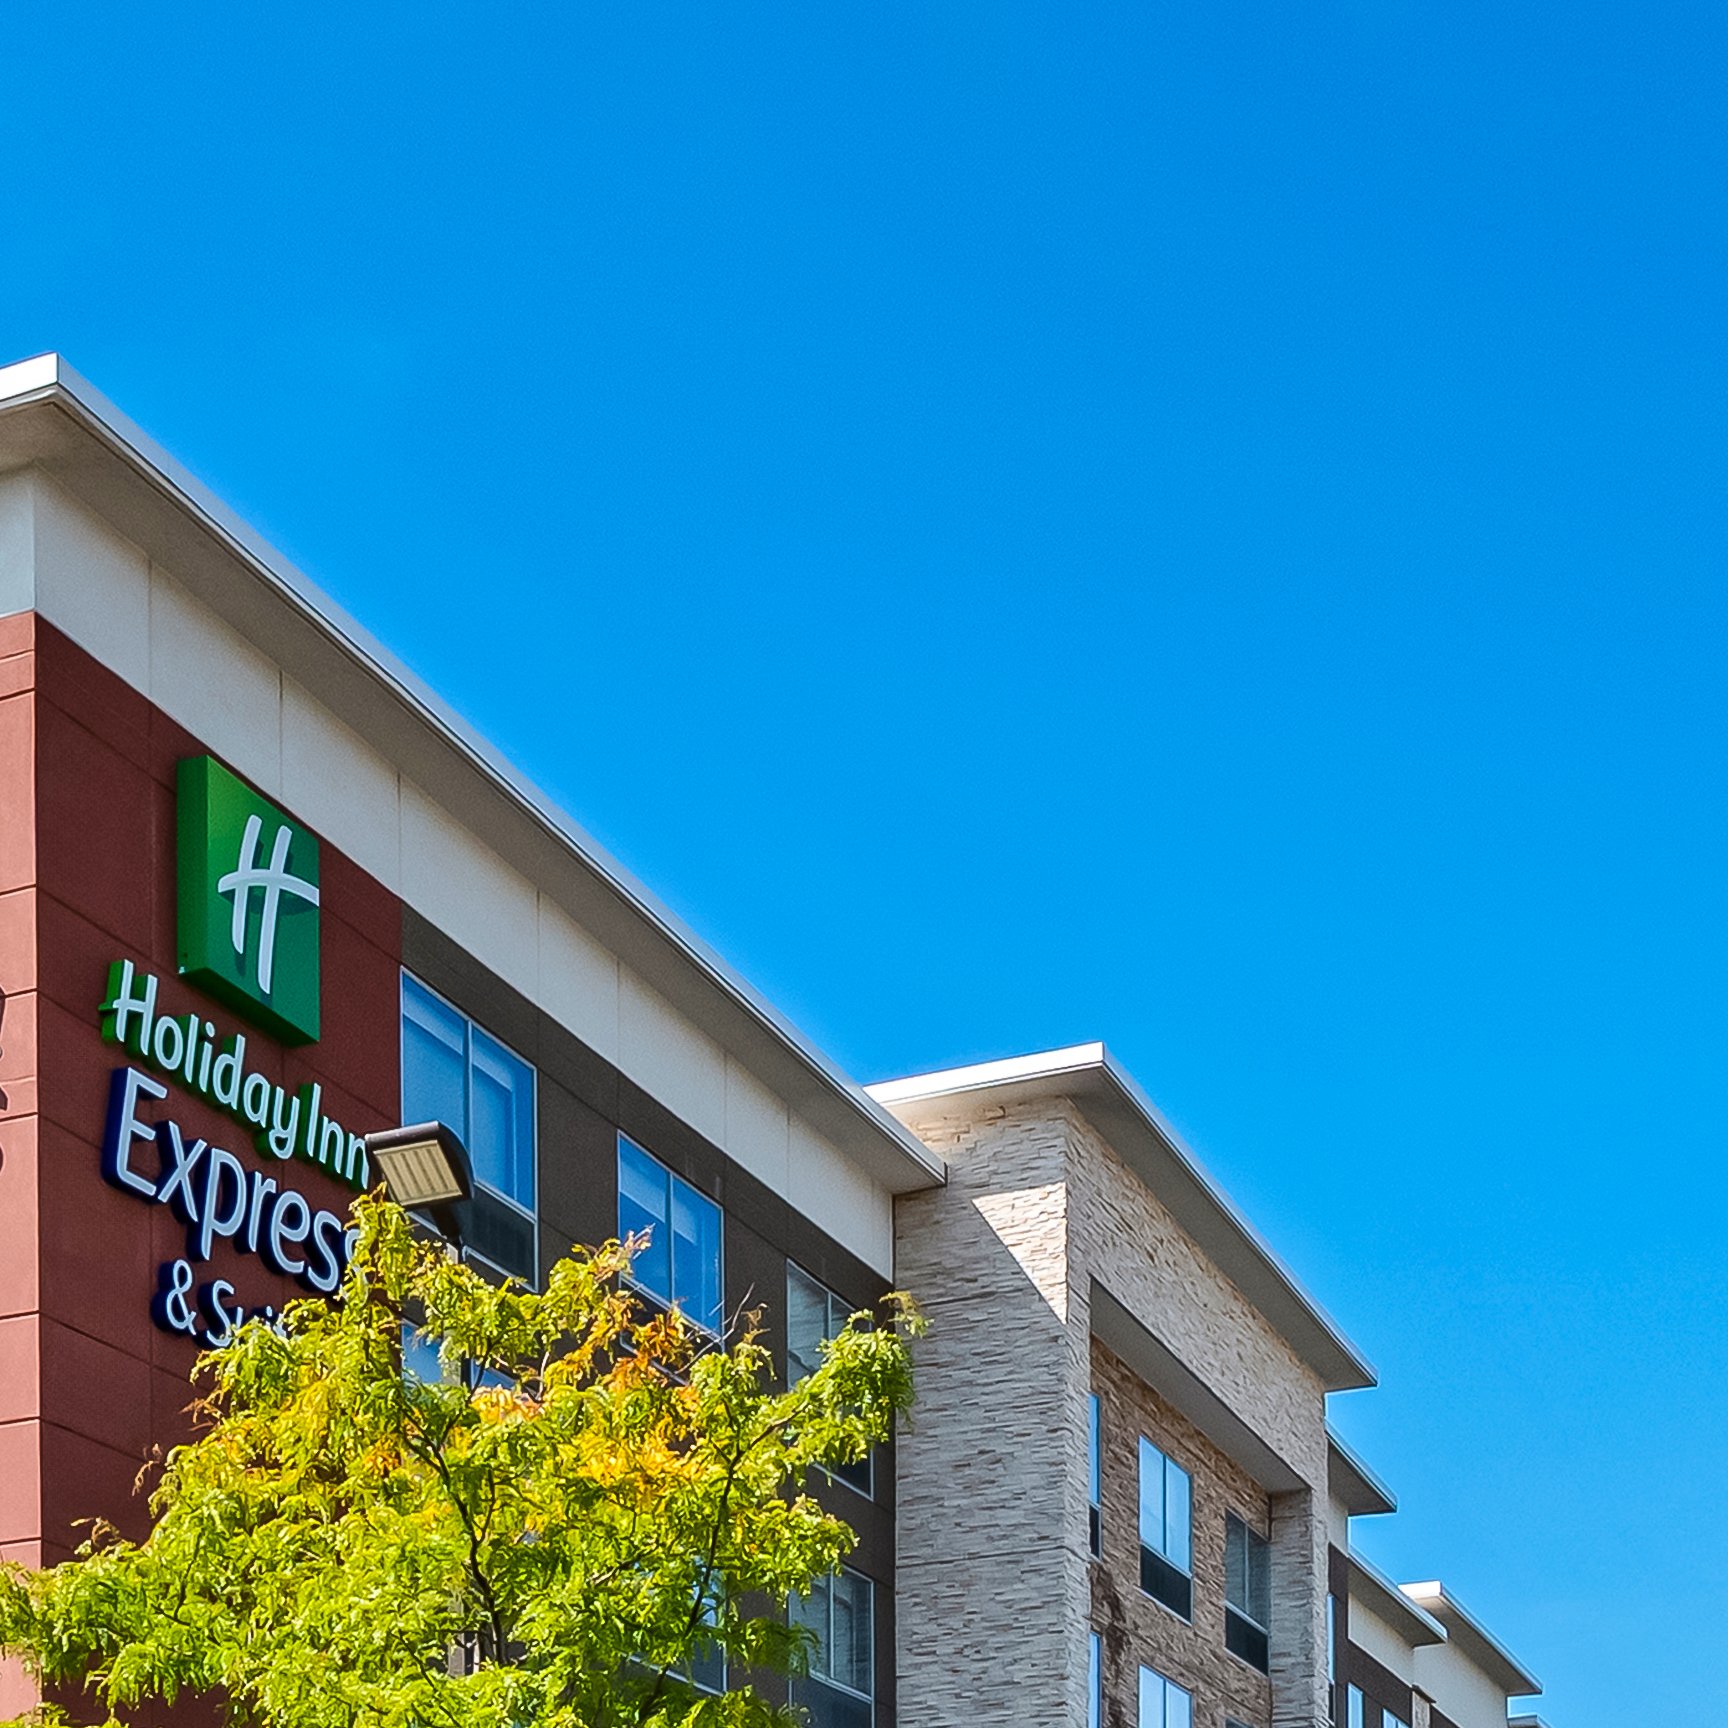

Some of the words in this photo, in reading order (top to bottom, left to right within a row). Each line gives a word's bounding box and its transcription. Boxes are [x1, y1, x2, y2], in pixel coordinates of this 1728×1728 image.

[217, 813, 320, 995] H
[110, 958, 301, 1160] Holiday
[306, 1082, 371, 1190] Inn
[165, 1259, 197, 1336] &
